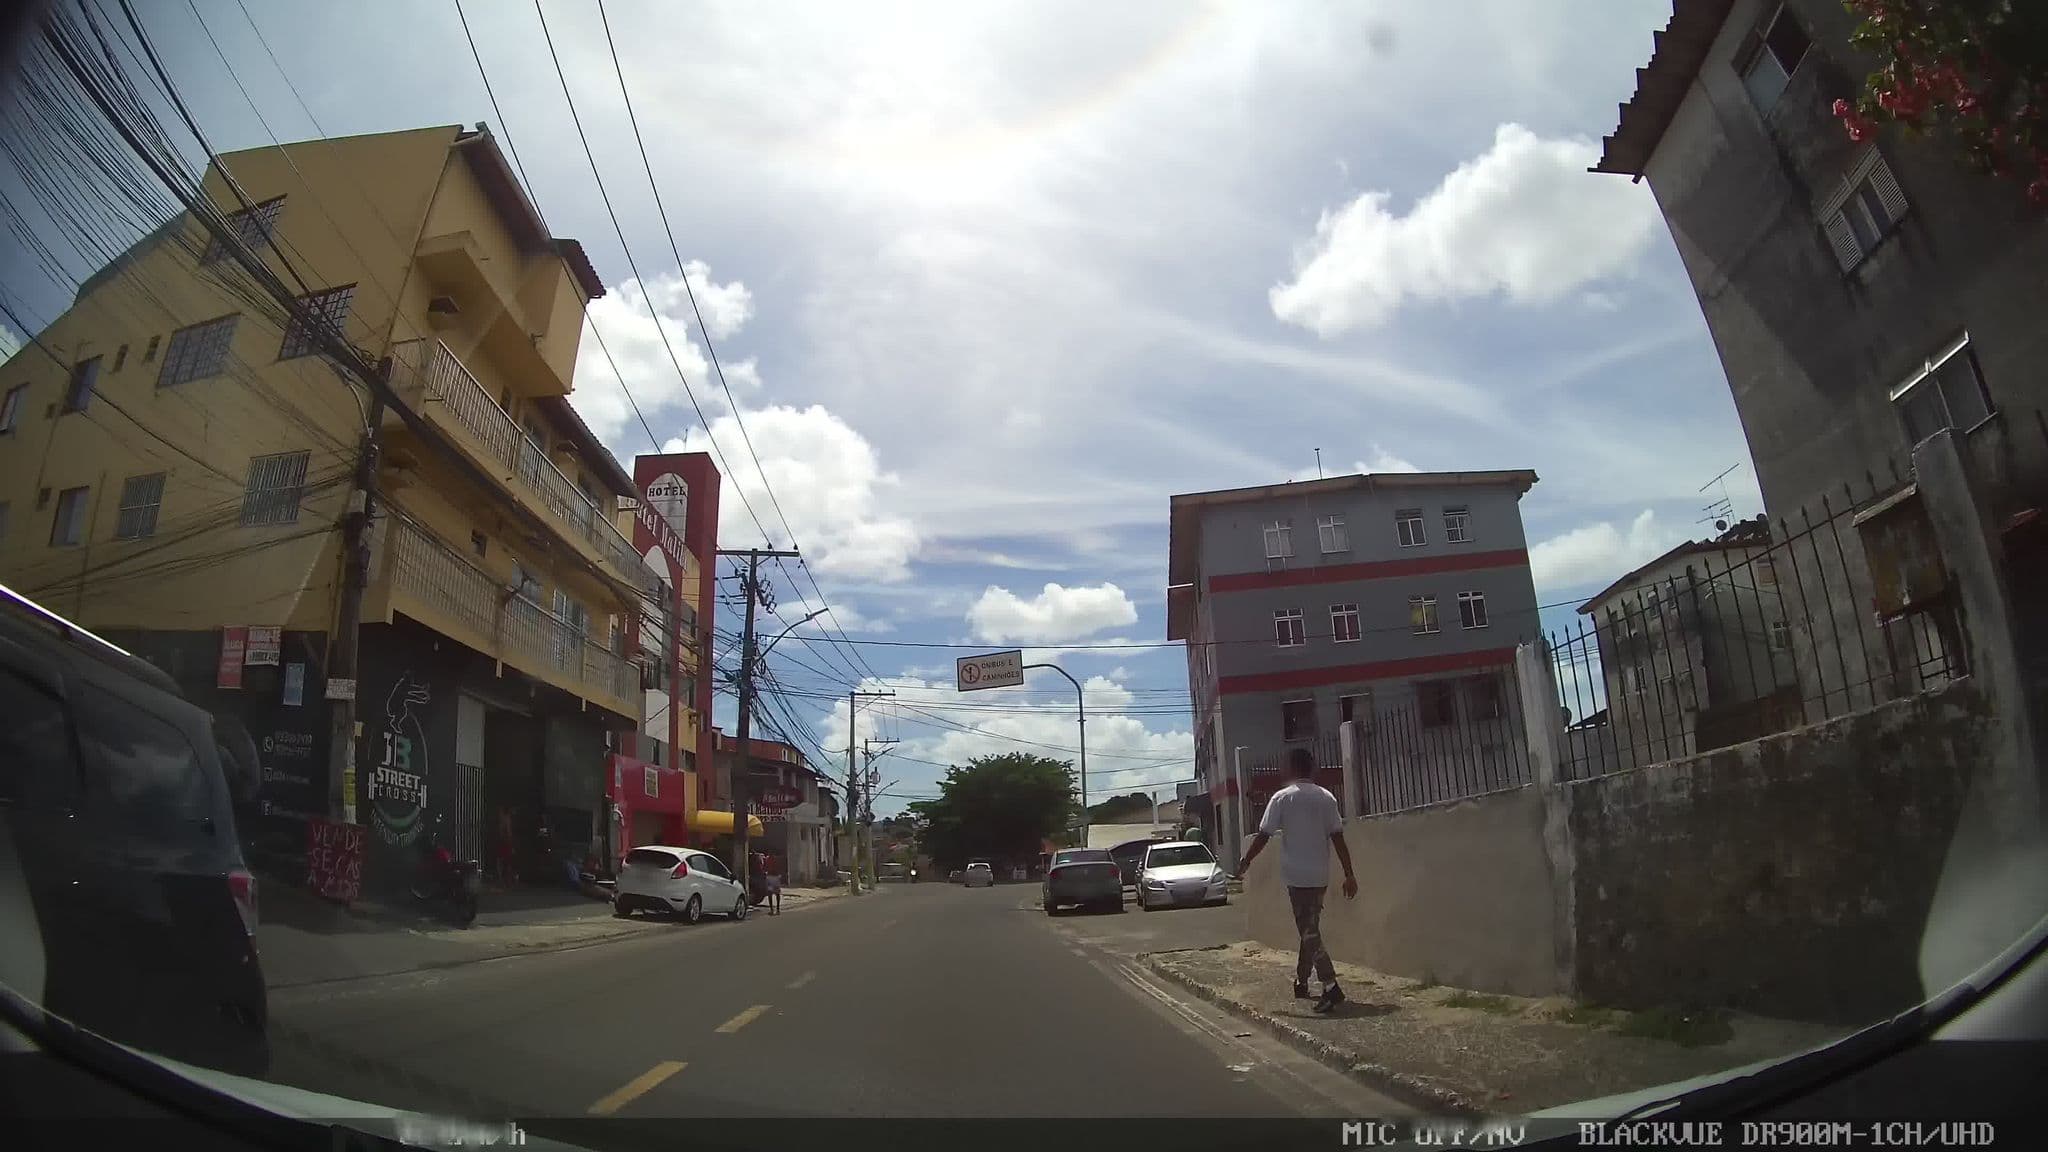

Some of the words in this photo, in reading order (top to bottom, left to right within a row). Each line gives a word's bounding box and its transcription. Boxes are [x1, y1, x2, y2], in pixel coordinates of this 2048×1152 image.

[648, 486, 687, 497] HOTEL
[377, 766, 421, 791] STREET
[378, 784, 417, 803] CROSS
